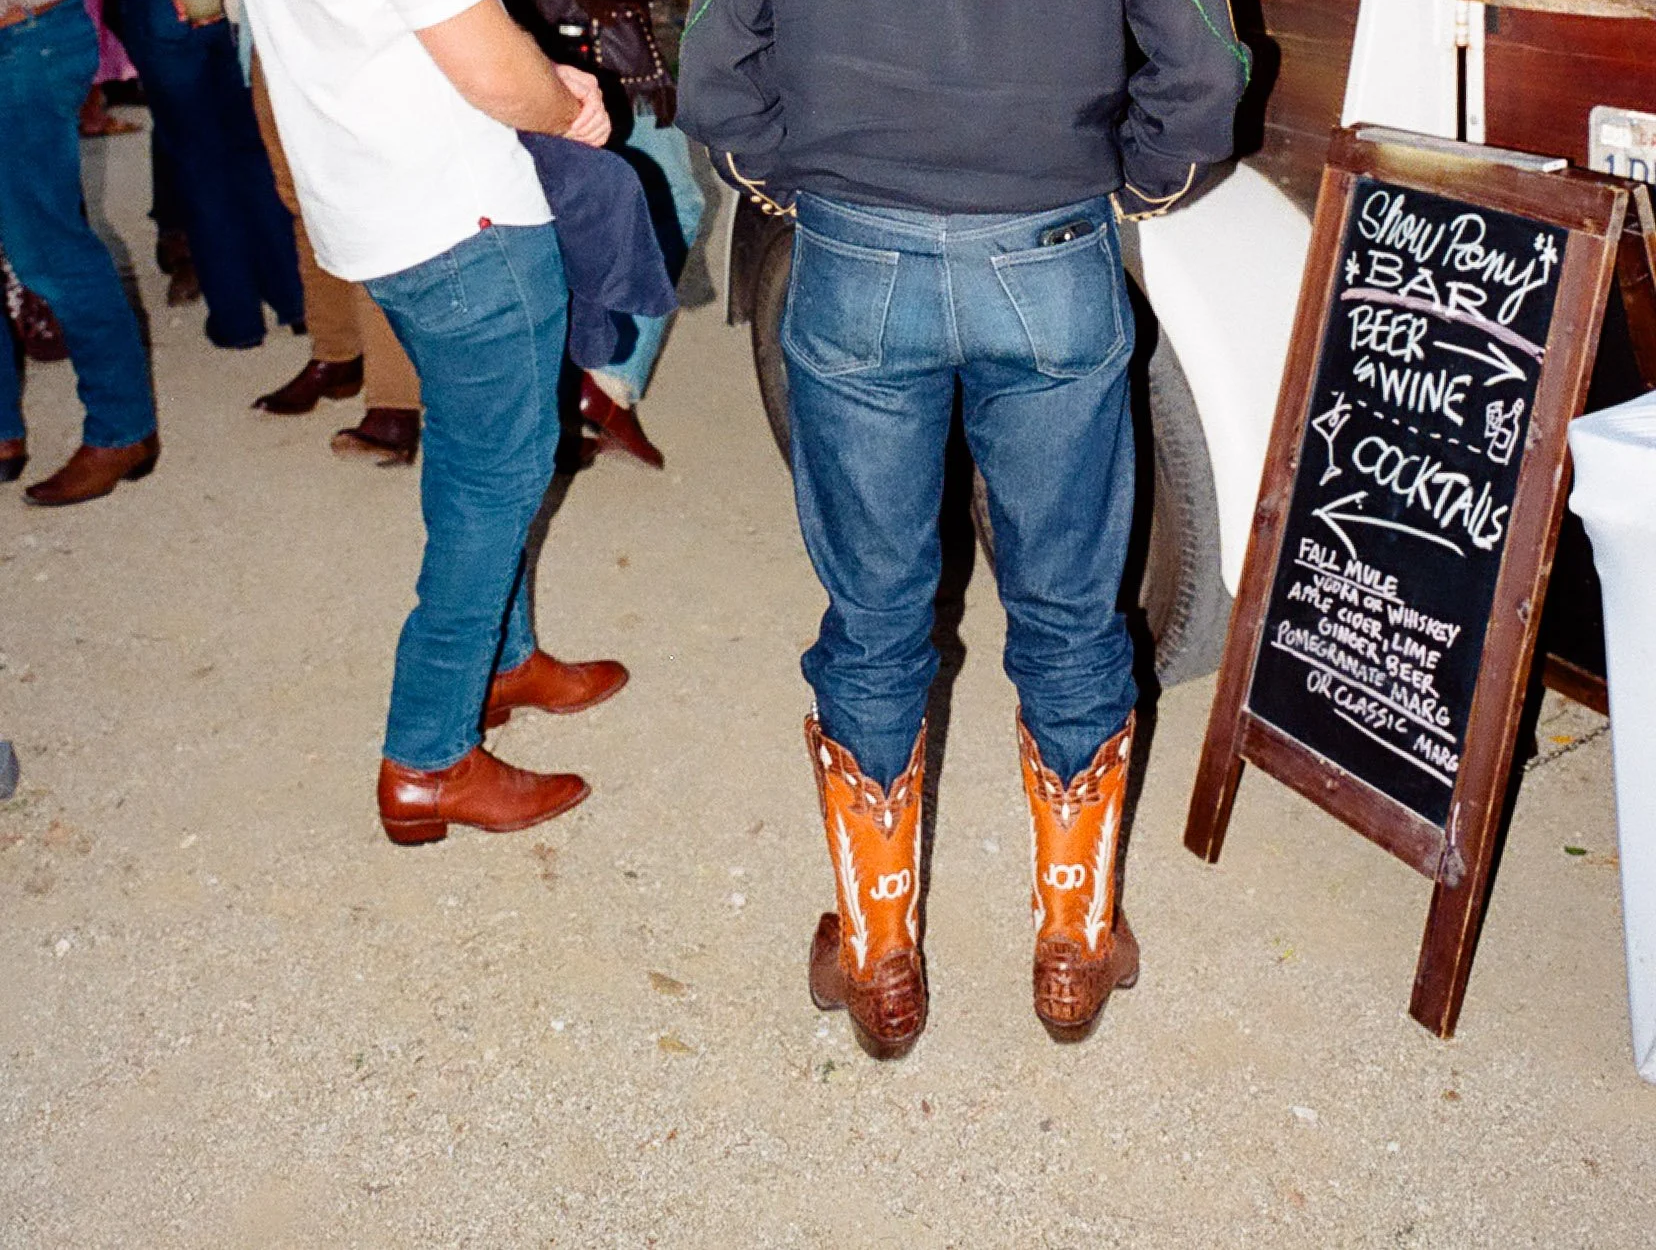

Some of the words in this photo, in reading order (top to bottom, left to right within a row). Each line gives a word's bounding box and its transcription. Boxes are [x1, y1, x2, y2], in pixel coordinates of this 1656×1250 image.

[1358, 190, 1446, 263] Show
[1441, 213, 1549, 325] Pony
[1365, 250, 1488, 322] BAR
[1347, 305, 1428, 362] BEER
[1378, 361, 1473, 426] WINE
[1299, 537, 1341, 571] FALL
[1344, 559, 1398, 598] MULE
[1287, 581, 1334, 613] APPLE
[1391, 632, 1441, 669] LIME
[1313, 574, 1359, 606] VODKA
[1363, 596, 1383, 613] OR
[1387, 603, 1461, 648] WHISKEY
[1276, 620, 1388, 687] POMEGRANATE
[1390, 682, 1451, 727] MARG
[1318, 616, 1380, 664] GINGER
[1385, 655, 1440, 699] BEER
[1306, 670, 1332, 699] OR
[1334, 686, 1408, 733] CLASSIC
[1413, 734, 1459, 772] MARG
